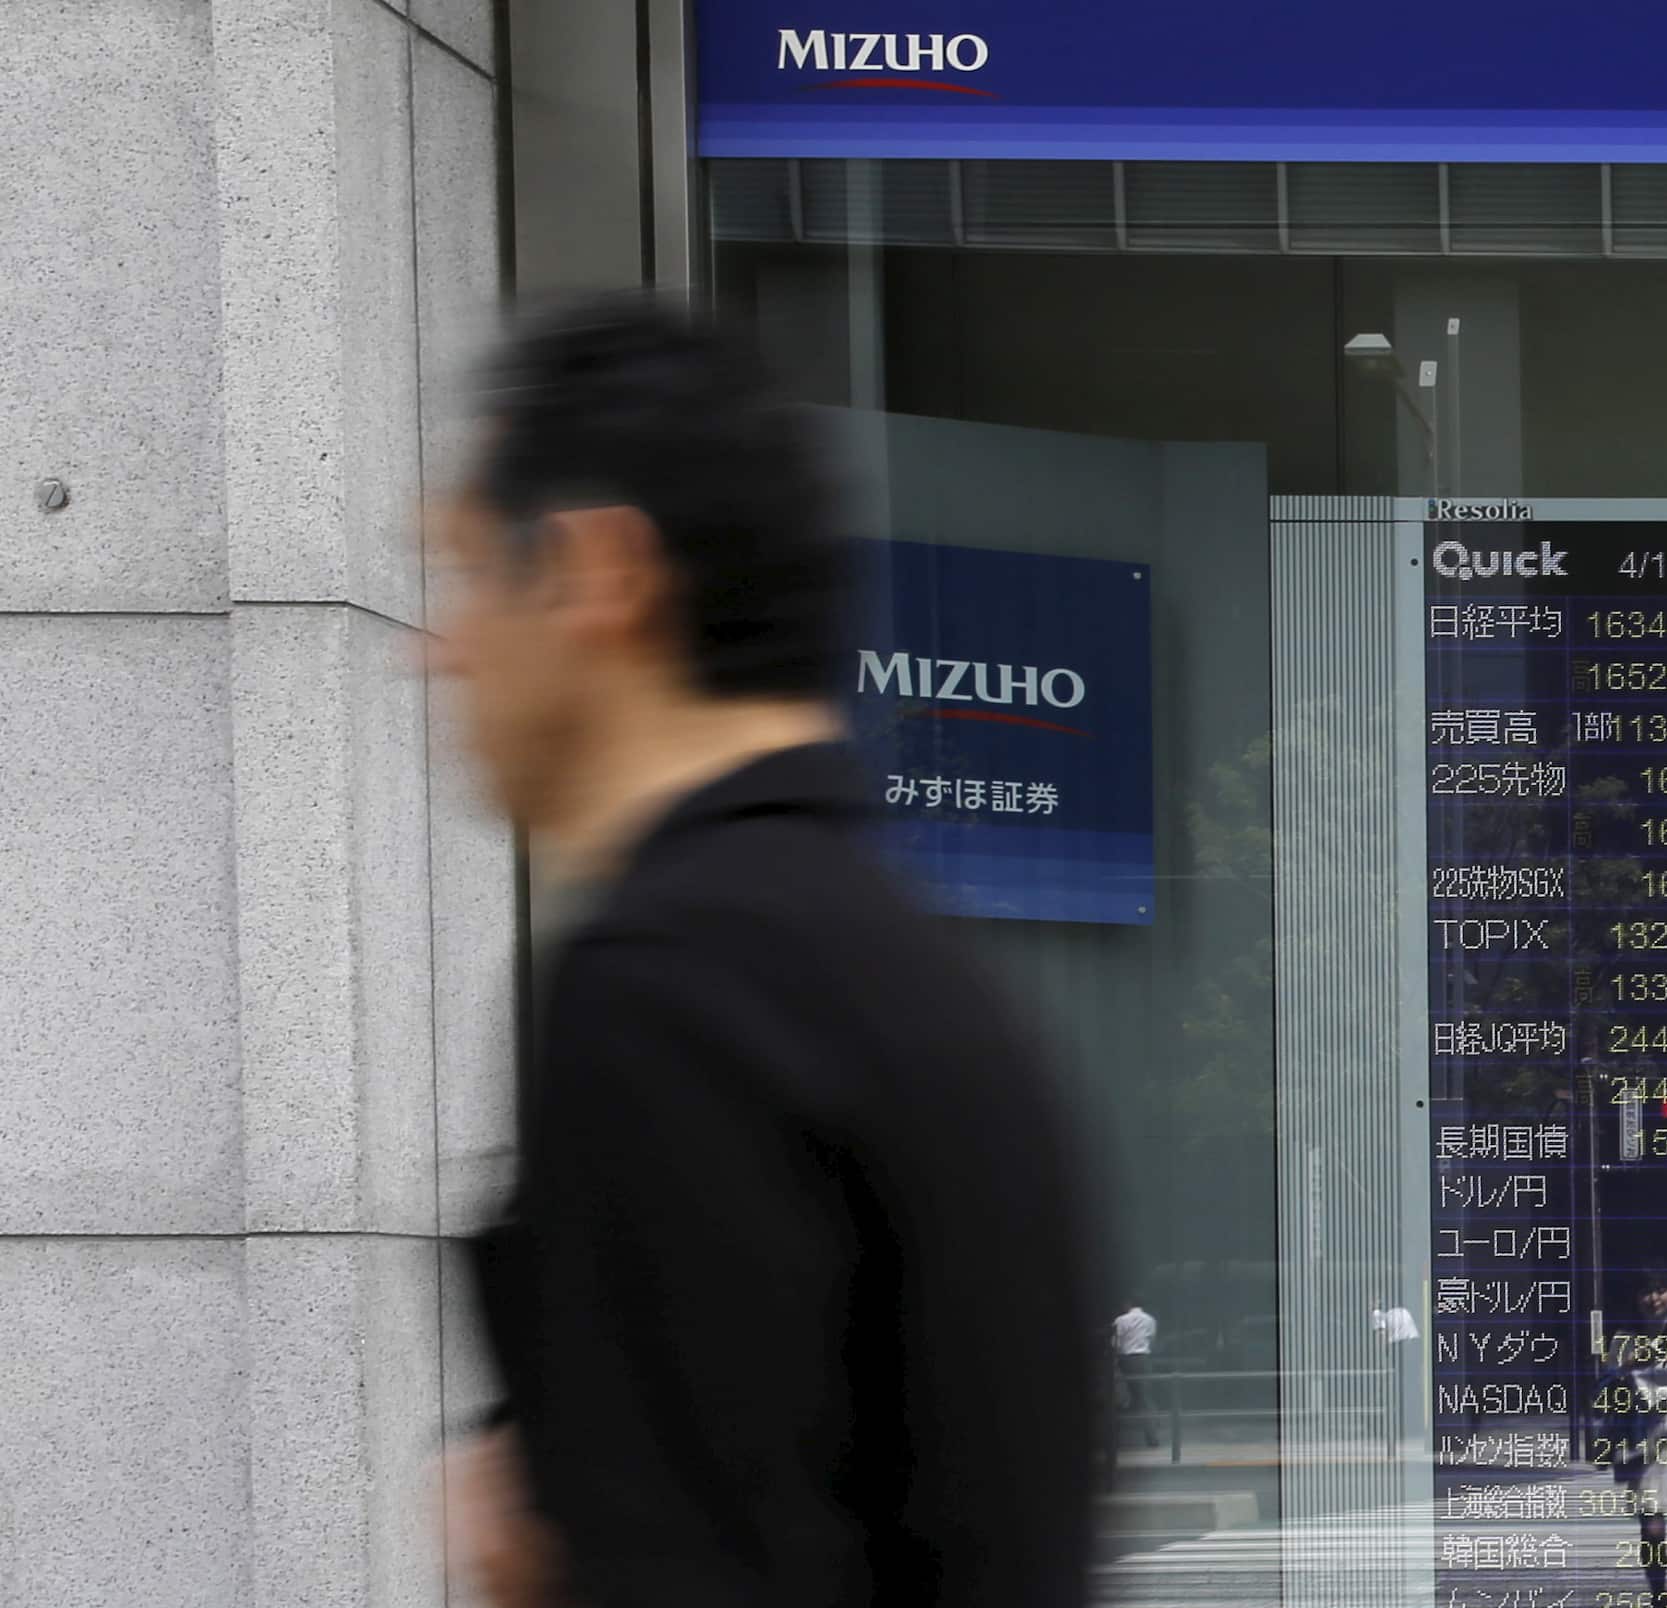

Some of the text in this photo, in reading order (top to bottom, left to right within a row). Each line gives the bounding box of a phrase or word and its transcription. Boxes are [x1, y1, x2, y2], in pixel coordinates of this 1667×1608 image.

[777, 28, 988, 72] MIZUHO
[1438, 498, 1533, 520] Resolia
[1430, 603, 1562, 641] 日経平均
[857, 650, 1085, 708] MIZUHO
[1431, 709, 1538, 745] 売買高
[885, 774, 1059, 816] みずほ証券
[1431, 762, 1567, 797] 225先物
[1432, 919, 1550, 950] TOPIX
[1435, 1124, 1569, 1162] 長期国債
[1441, 1174, 1547, 1208] ドル/円
[1437, 1226, 1571, 1260] ユーロ/円
[1438, 1383, 1568, 1415] NASDAQ
[1439, 1533, 1574, 1571] 韓国総合
